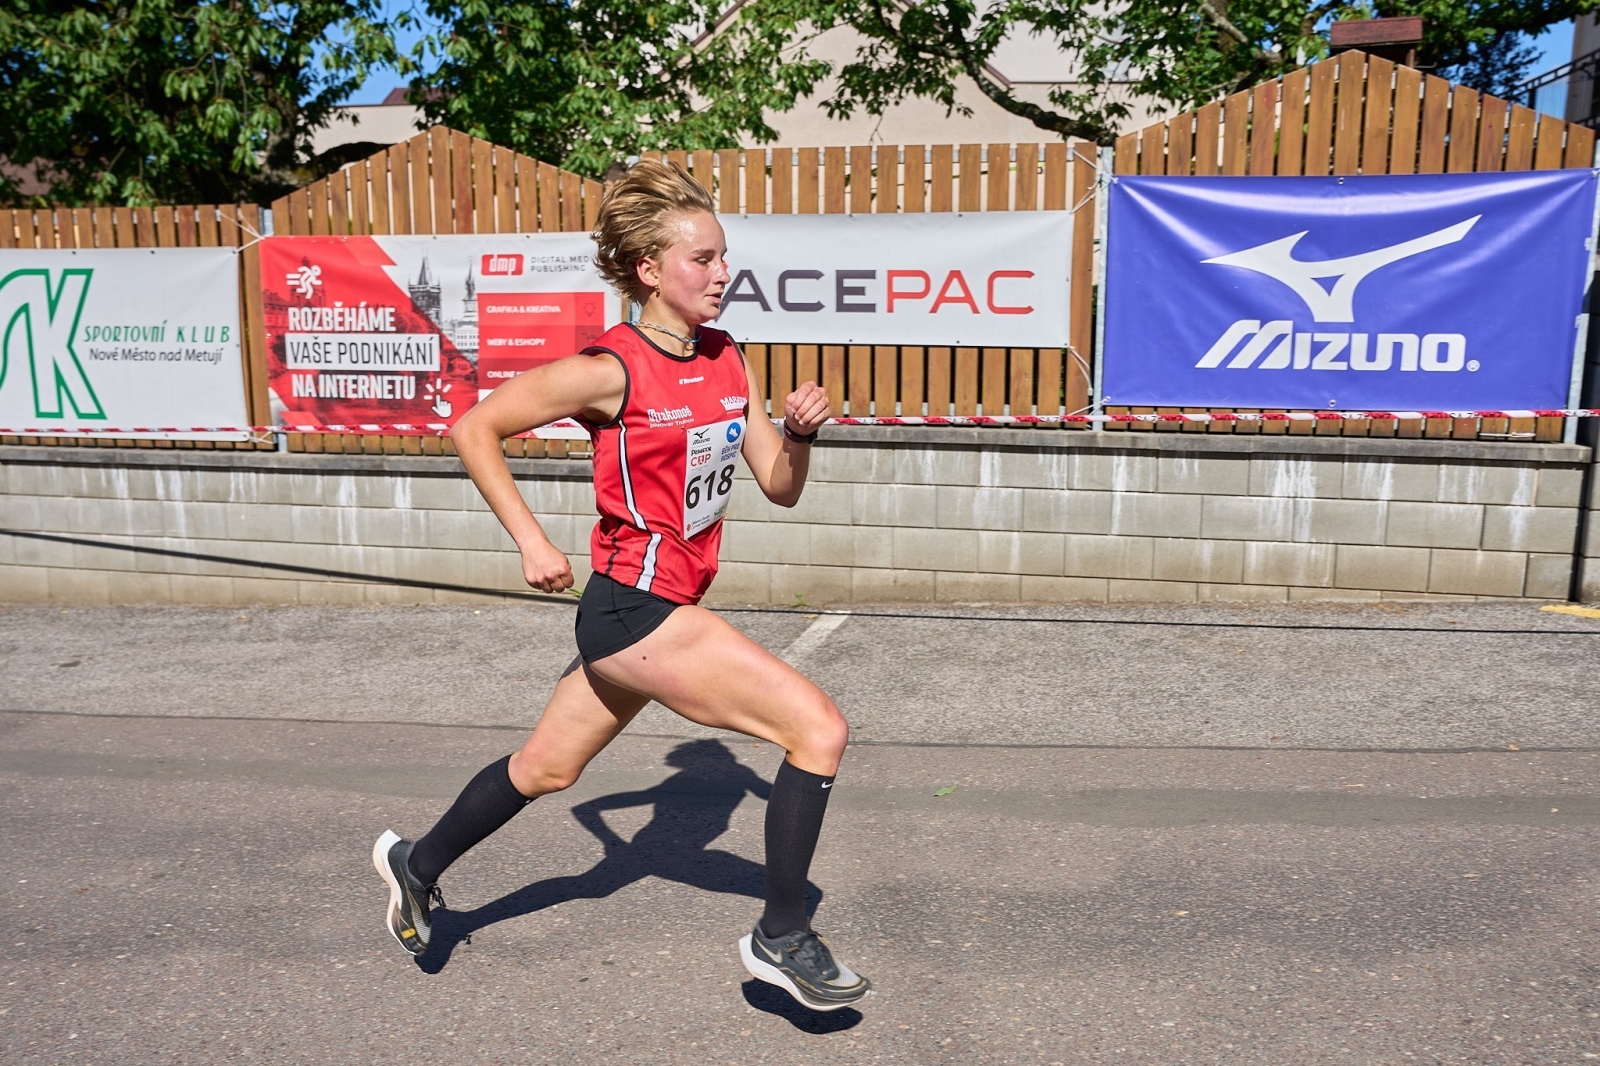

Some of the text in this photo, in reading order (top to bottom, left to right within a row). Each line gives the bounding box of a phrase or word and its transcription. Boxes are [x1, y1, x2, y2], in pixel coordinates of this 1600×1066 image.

[489, 255, 517, 276] dmp
[531, 256, 566, 264] DIGITAL
[531, 264, 586, 273] PUBLISHING
[713, 269, 1035, 320] ACEPAC
[288, 301, 397, 332] ROZBĚHÁME
[486, 305, 519, 314] GRAFIKA
[526, 305, 561, 313] KREATIVA
[290, 336, 434, 365] VAŠE PODNIKÁNÍ
[514, 338, 546, 346] ESHOPY
[89, 348, 224, 365] Nové Město nad Metují
[487, 370, 516, 378] ONLINE
[292, 374, 416, 399] NA INTERNETU
[690, 453, 712, 467] CUP
[685, 463, 735, 510] 618
